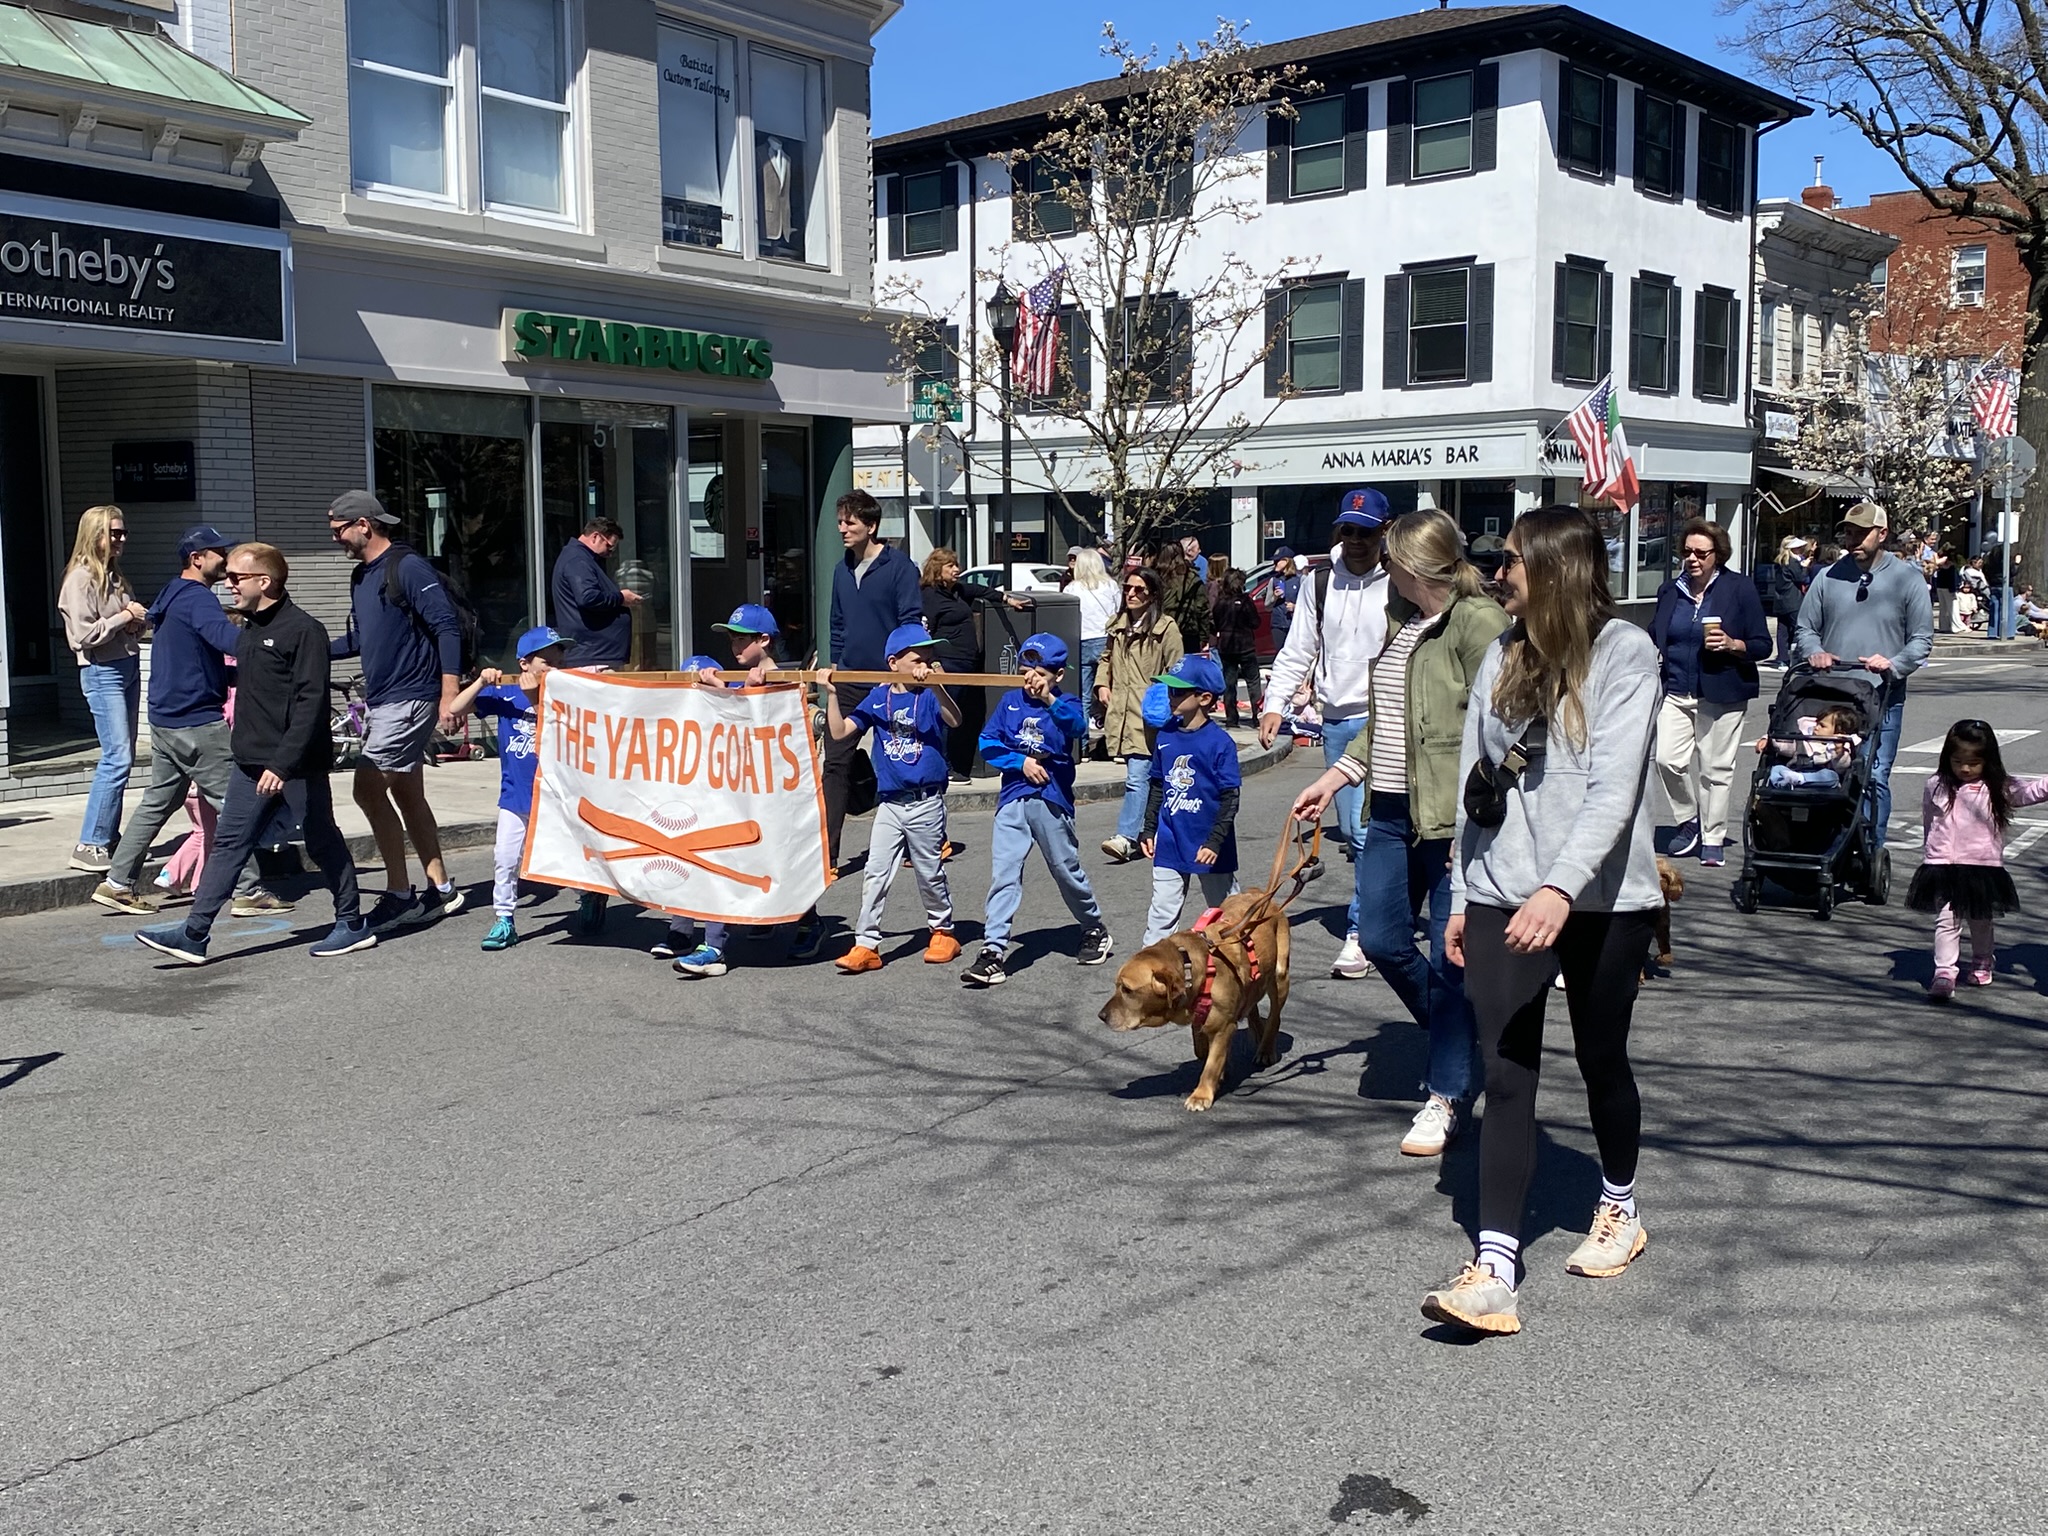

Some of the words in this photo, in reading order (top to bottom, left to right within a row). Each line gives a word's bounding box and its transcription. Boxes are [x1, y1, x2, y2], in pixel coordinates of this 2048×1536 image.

[680, 54, 713, 75] Batista
[663, 68, 692, 88] Custom
[693, 77, 730, 103] Tailoring
[119, 303, 175, 322] REALTY
[514, 311, 774, 380] STARBUCKS
[594, 420, 617, 449] 51
[153, 461, 188, 476] Sotheby's
[1321, 451, 1365, 469] ANNA
[1371, 447, 1432, 467] MARIA'S
[1446, 445, 1479, 464] BAR
[551, 700, 597, 775] THE
[604, 714, 702, 786] YARD
[708, 723, 800, 794] GOATS
